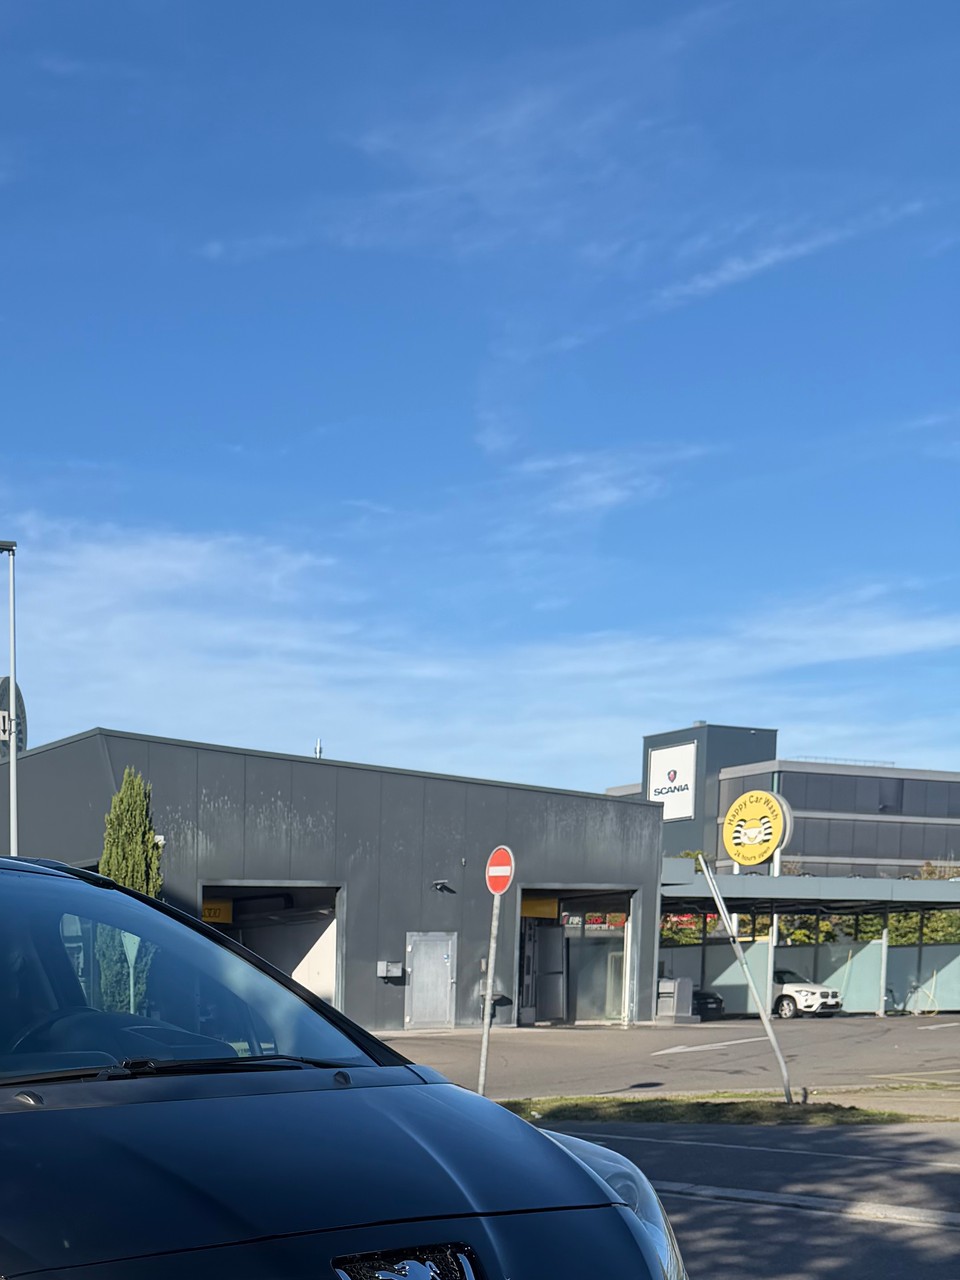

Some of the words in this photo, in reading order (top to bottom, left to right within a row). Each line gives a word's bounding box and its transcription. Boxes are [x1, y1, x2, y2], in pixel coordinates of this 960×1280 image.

[653, 783, 689, 796] SCANIA
[727, 800, 747, 826] Happy
[748, 795, 763, 804] Car
[763, 797, 779, 821] Wash
